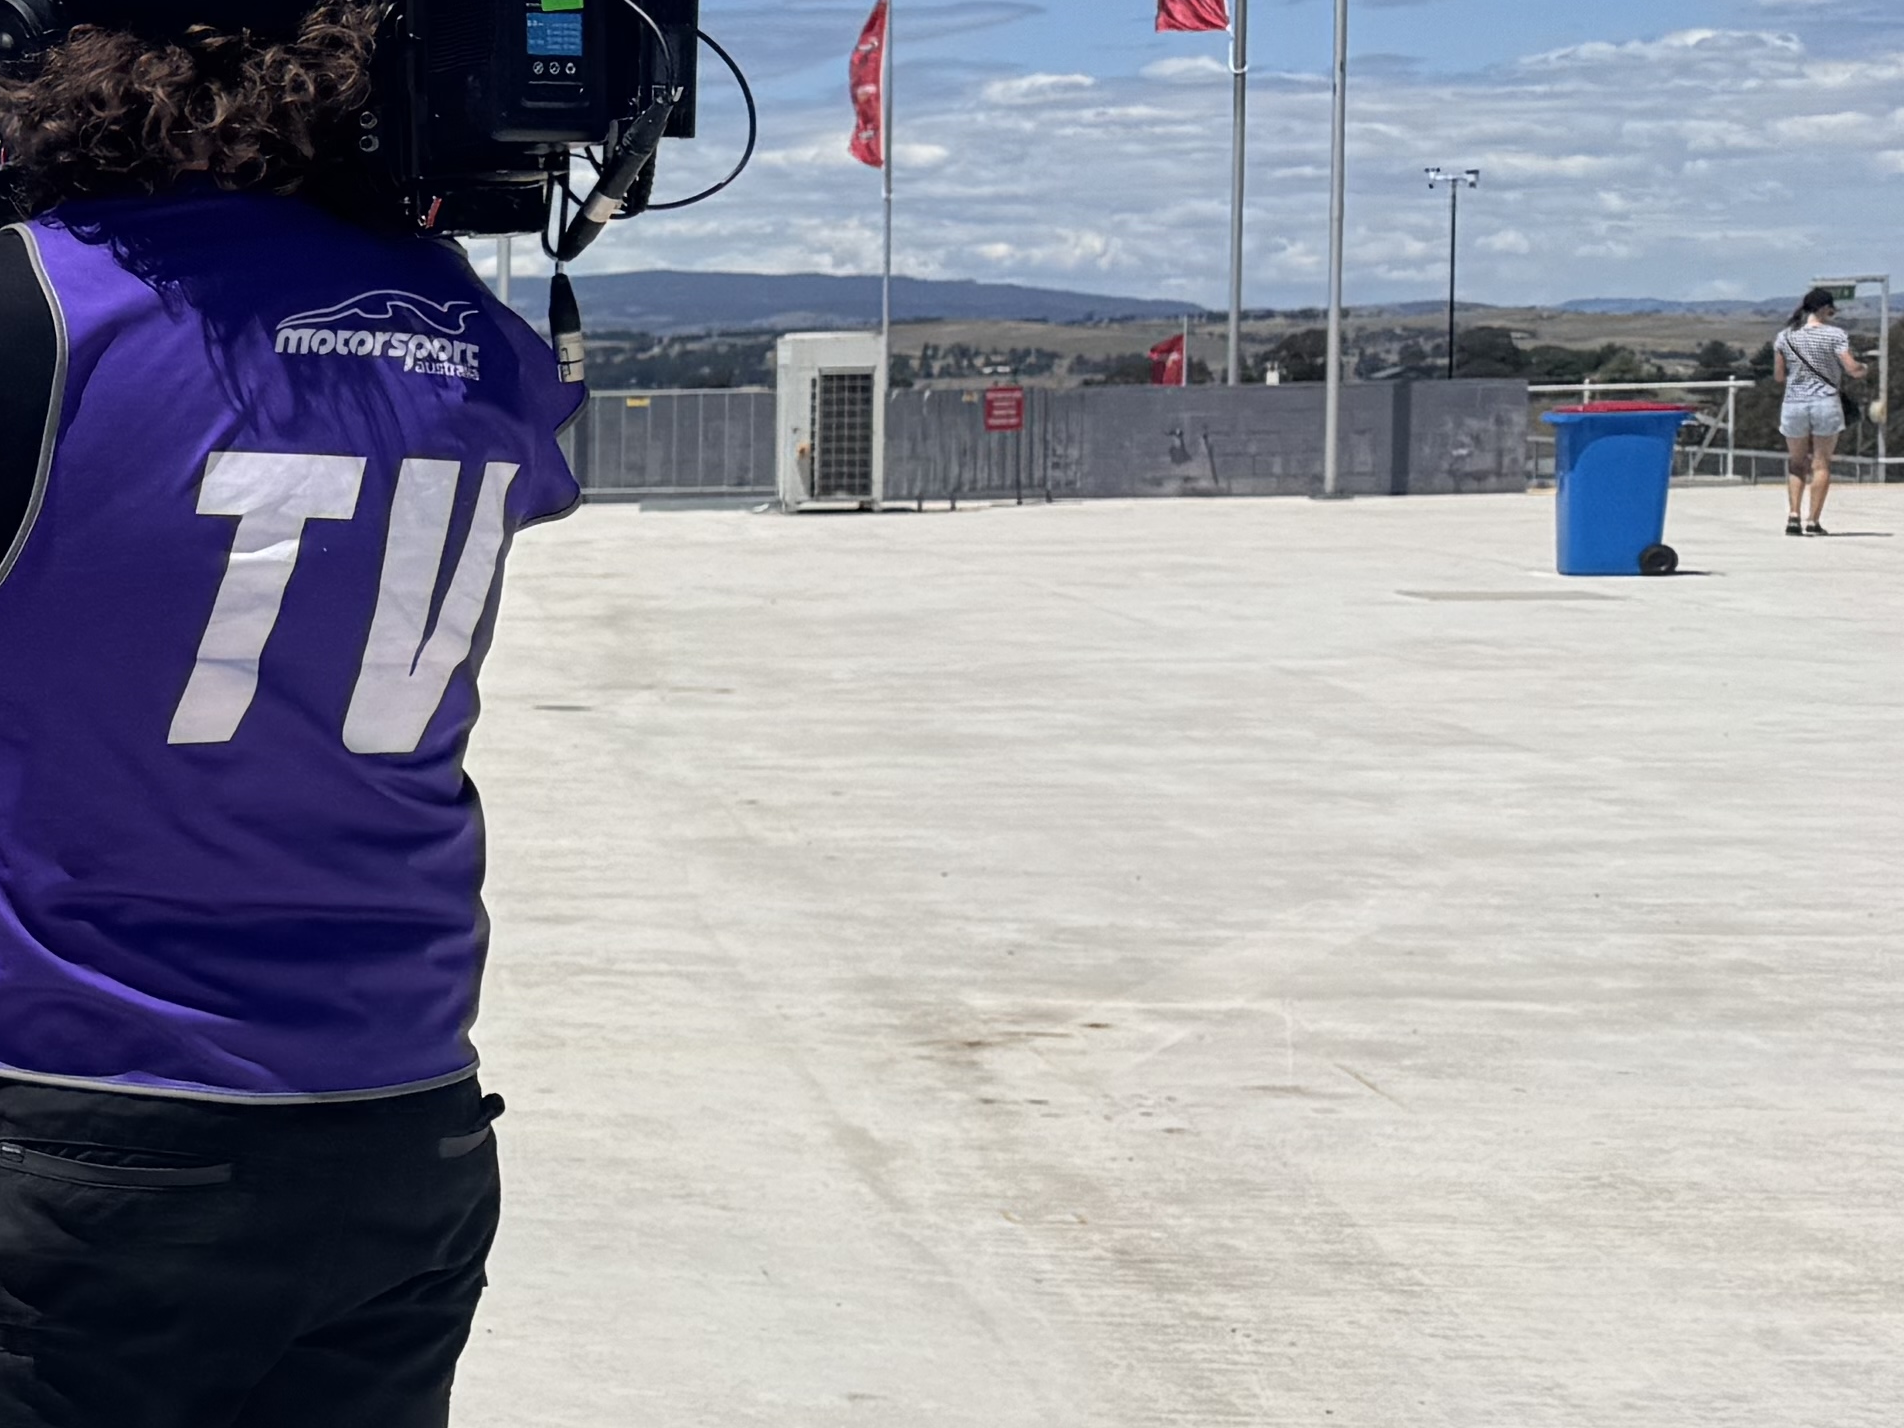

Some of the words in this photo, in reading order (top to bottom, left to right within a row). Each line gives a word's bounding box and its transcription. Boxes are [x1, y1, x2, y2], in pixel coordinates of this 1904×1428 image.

[274, 327, 480, 371] motorsport
[414, 358, 480, 381] australia
[167, 451, 520, 754] TV
